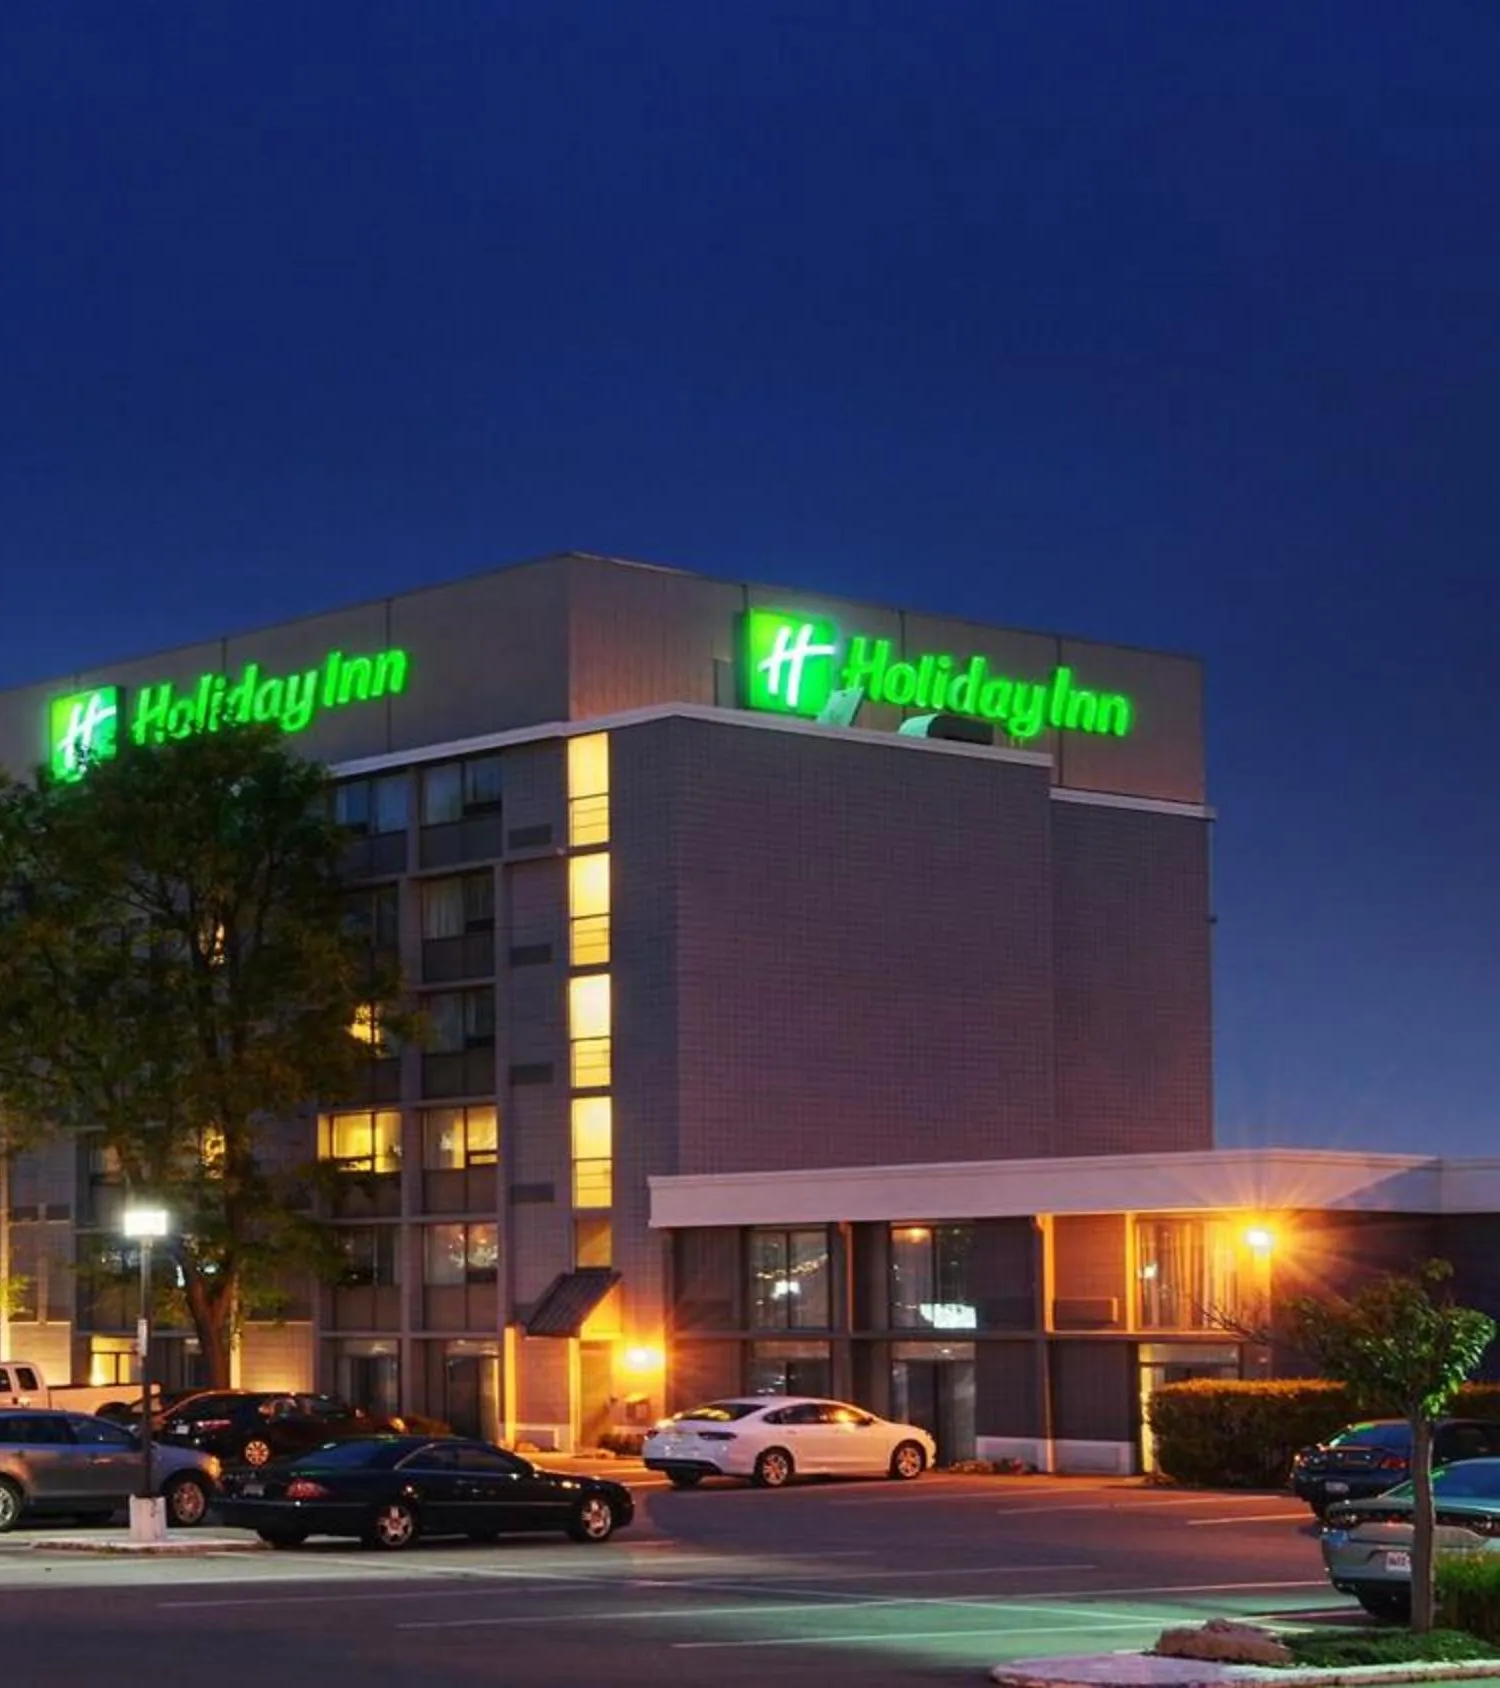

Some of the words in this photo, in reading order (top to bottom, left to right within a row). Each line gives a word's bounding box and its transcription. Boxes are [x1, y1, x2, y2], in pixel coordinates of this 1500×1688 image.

[130, 662, 319, 745] Holiday
[323, 649, 407, 707] Inn
[841, 636, 1048, 738] Holiday
[1050, 666, 1130, 737] Inn
